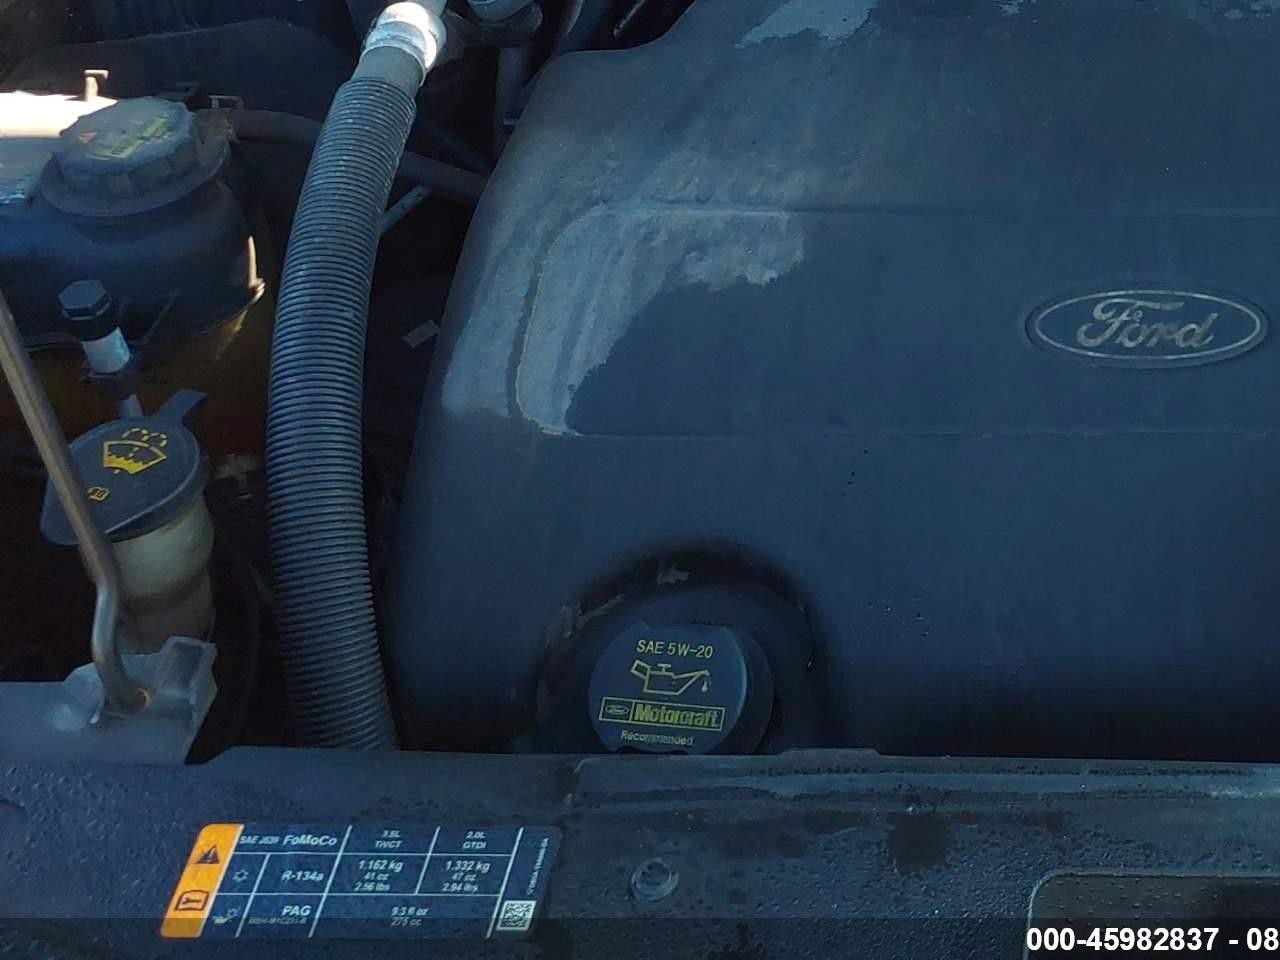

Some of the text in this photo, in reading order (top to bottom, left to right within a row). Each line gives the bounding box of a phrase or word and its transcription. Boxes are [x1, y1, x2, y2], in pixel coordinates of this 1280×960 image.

[1076, 298, 1218, 348] Ford
[636, 639, 714, 659] SAE 5W-20
[634, 703, 721, 728] Motorcraft
[620, 730, 694, 745] Recommended
[239, 835, 259, 844] SAE
[282, 834, 338, 846] FoMoCo
[358, 860, 404, 873] 1.162 kg
[445, 860, 491, 873] 1.332 kg
[281, 870, 324, 881] R-134a
[375, 882, 391, 891] lbs
[281, 905, 312, 916] PAG
